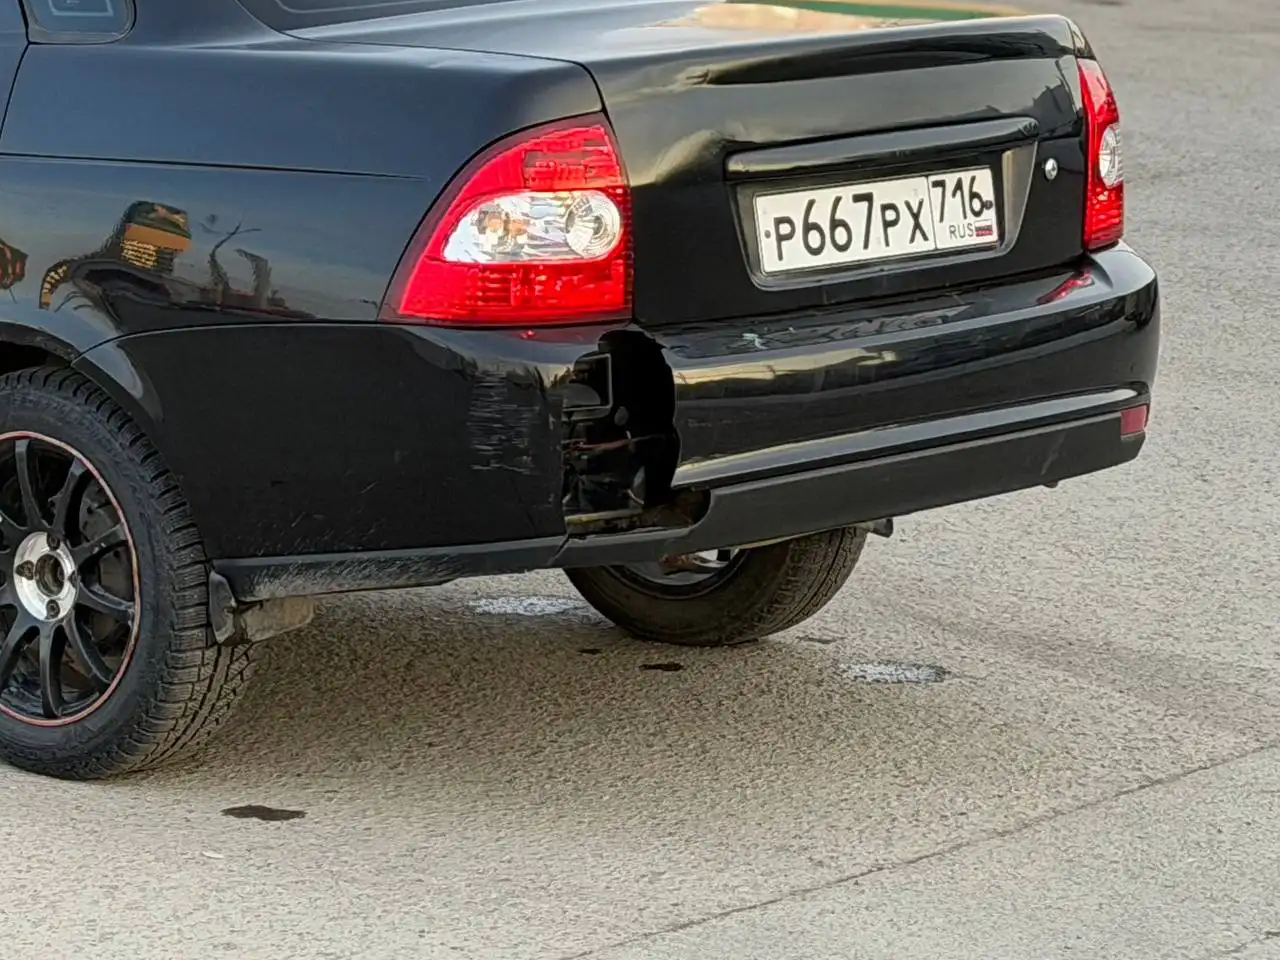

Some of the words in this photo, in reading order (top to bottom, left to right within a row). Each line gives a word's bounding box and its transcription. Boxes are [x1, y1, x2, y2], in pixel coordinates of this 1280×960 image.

[773, 191, 929, 261] Р667РХ
[931, 175, 984, 224] 716
[948, 221, 975, 240] RUS
